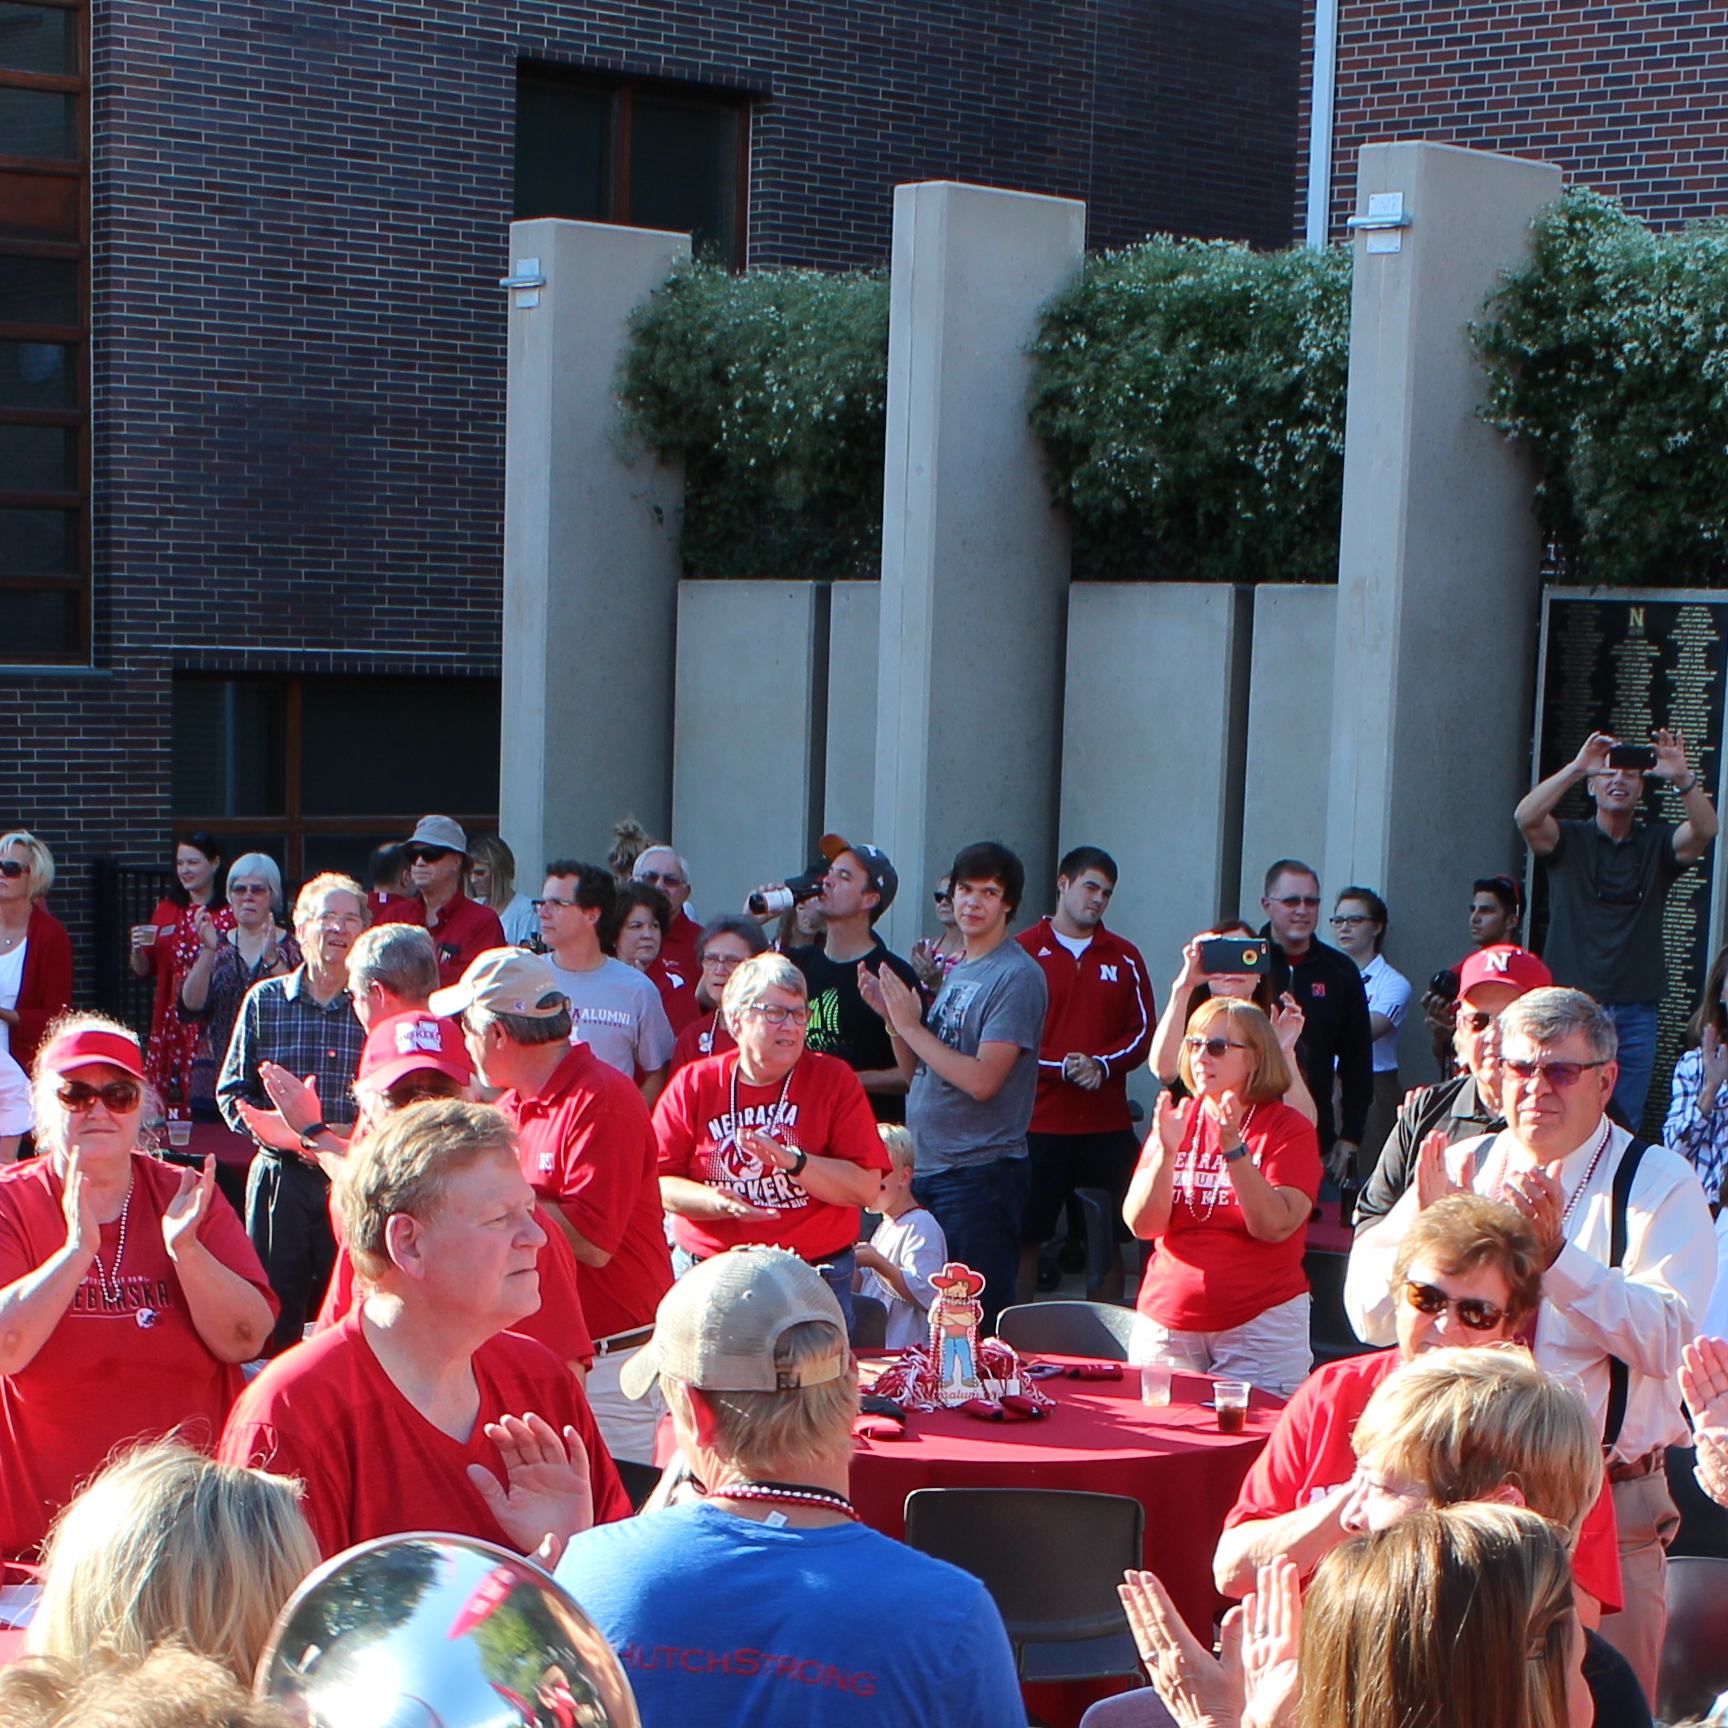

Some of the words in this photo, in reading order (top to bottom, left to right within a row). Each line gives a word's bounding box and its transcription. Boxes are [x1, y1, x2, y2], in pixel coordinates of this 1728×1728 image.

[1629, 607, 1645, 627] N
[1484, 952, 1512, 972] N
[1099, 965, 1118, 982] N
